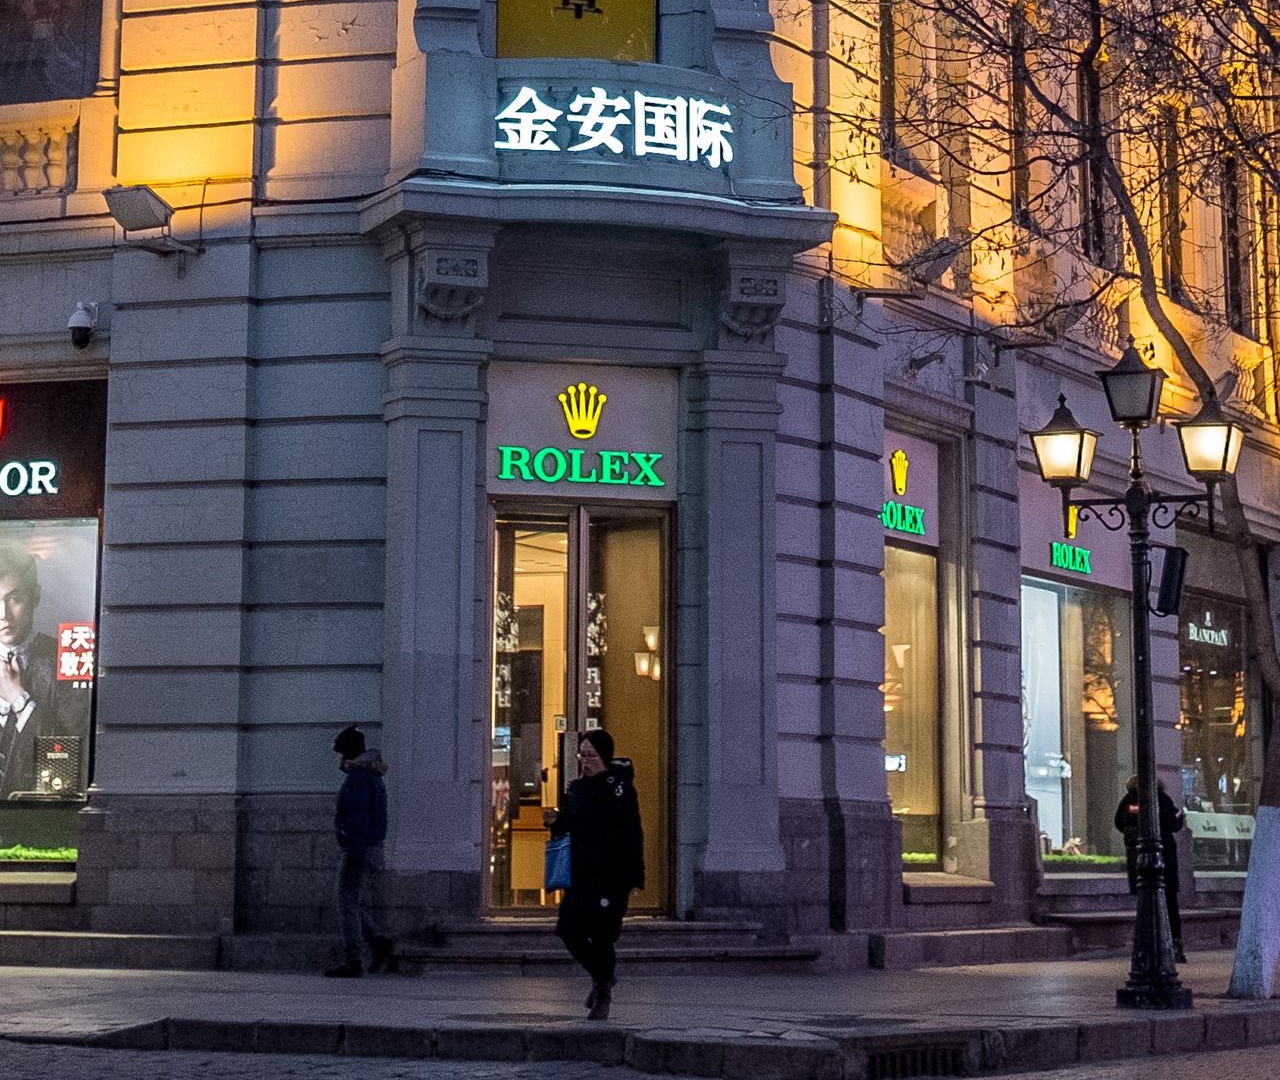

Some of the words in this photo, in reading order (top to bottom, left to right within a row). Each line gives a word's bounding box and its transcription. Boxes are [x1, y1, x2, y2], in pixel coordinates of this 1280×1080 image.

[494, 86, 733, 168] 金安国际
[498, 445, 666, 487] ROLEX
[1051, 541, 1092, 574] ROLEX
